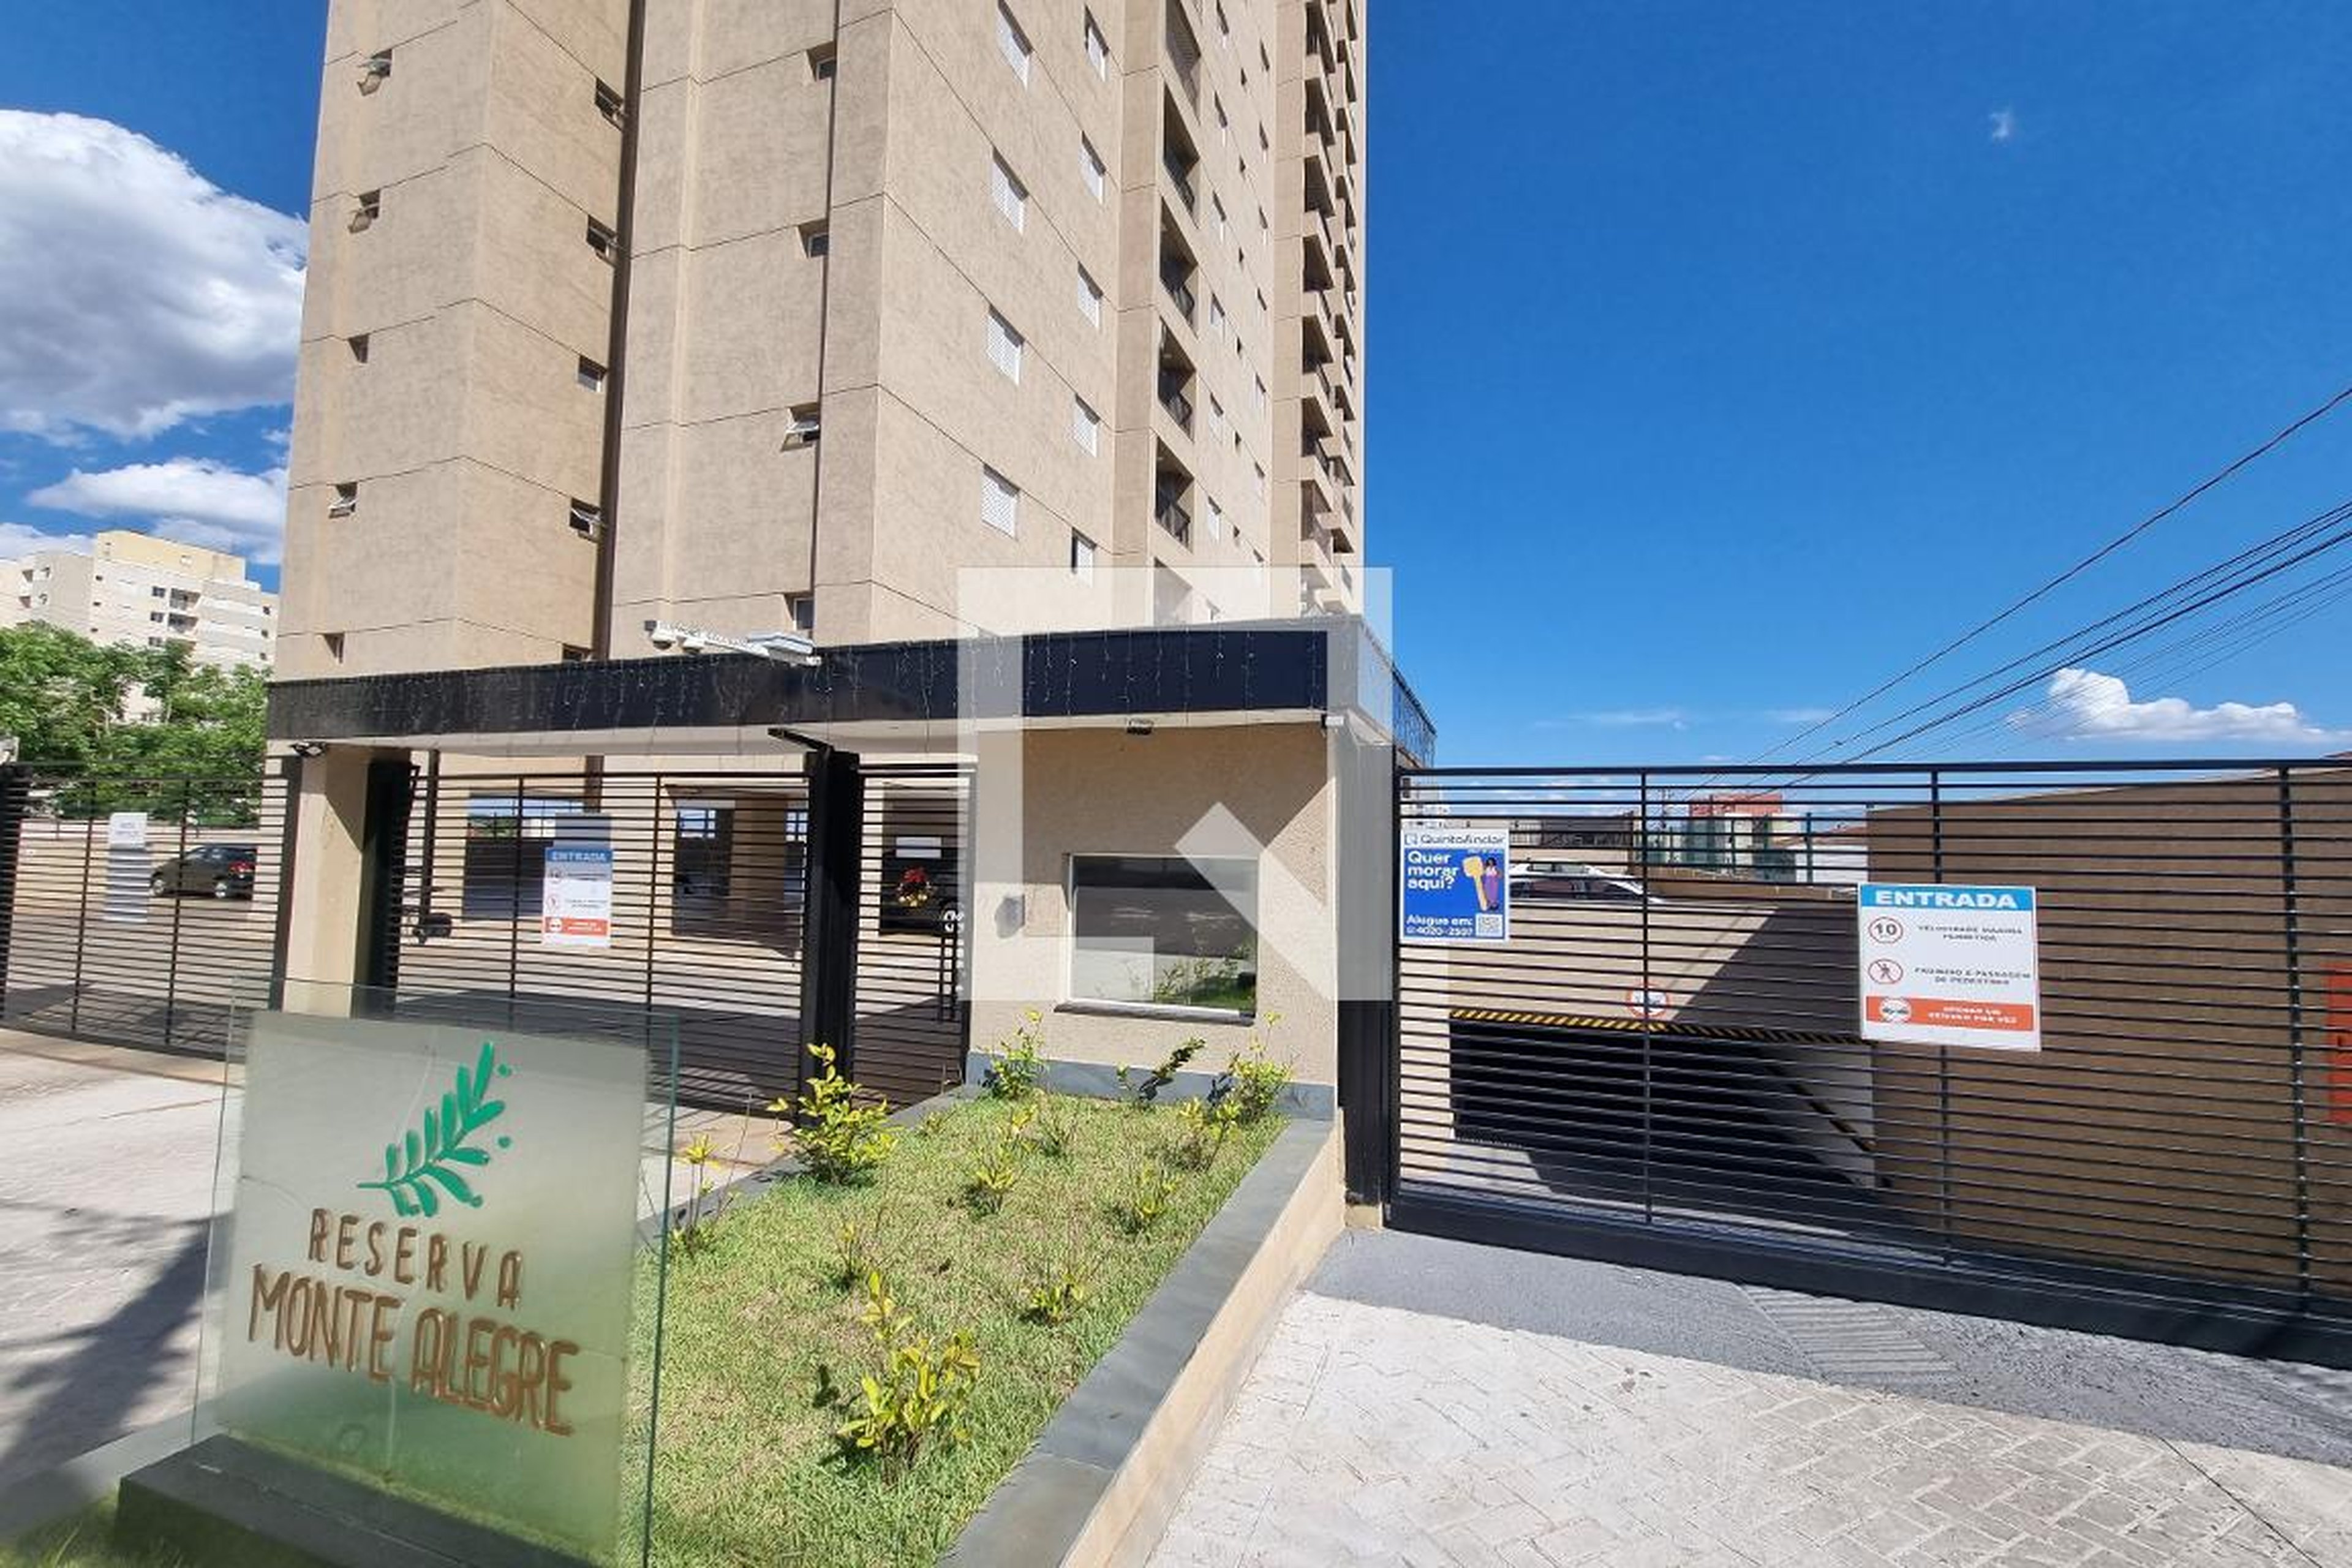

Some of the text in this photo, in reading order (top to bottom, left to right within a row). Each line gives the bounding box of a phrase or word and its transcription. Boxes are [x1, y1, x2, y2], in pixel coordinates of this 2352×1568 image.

[1408, 850, 1452, 864] Quer
[1408, 864, 1459, 876] morar
[1408, 876, 1455, 891] aqui?
[1875, 890, 2018, 909] ENTRADA
[1406, 914, 1449, 927] Alugue
[1874, 922, 1898, 936] 10
[309, 1207, 523, 1310] RESERVA
[247, 1262, 581, 1437] MONTE ALEGRE
